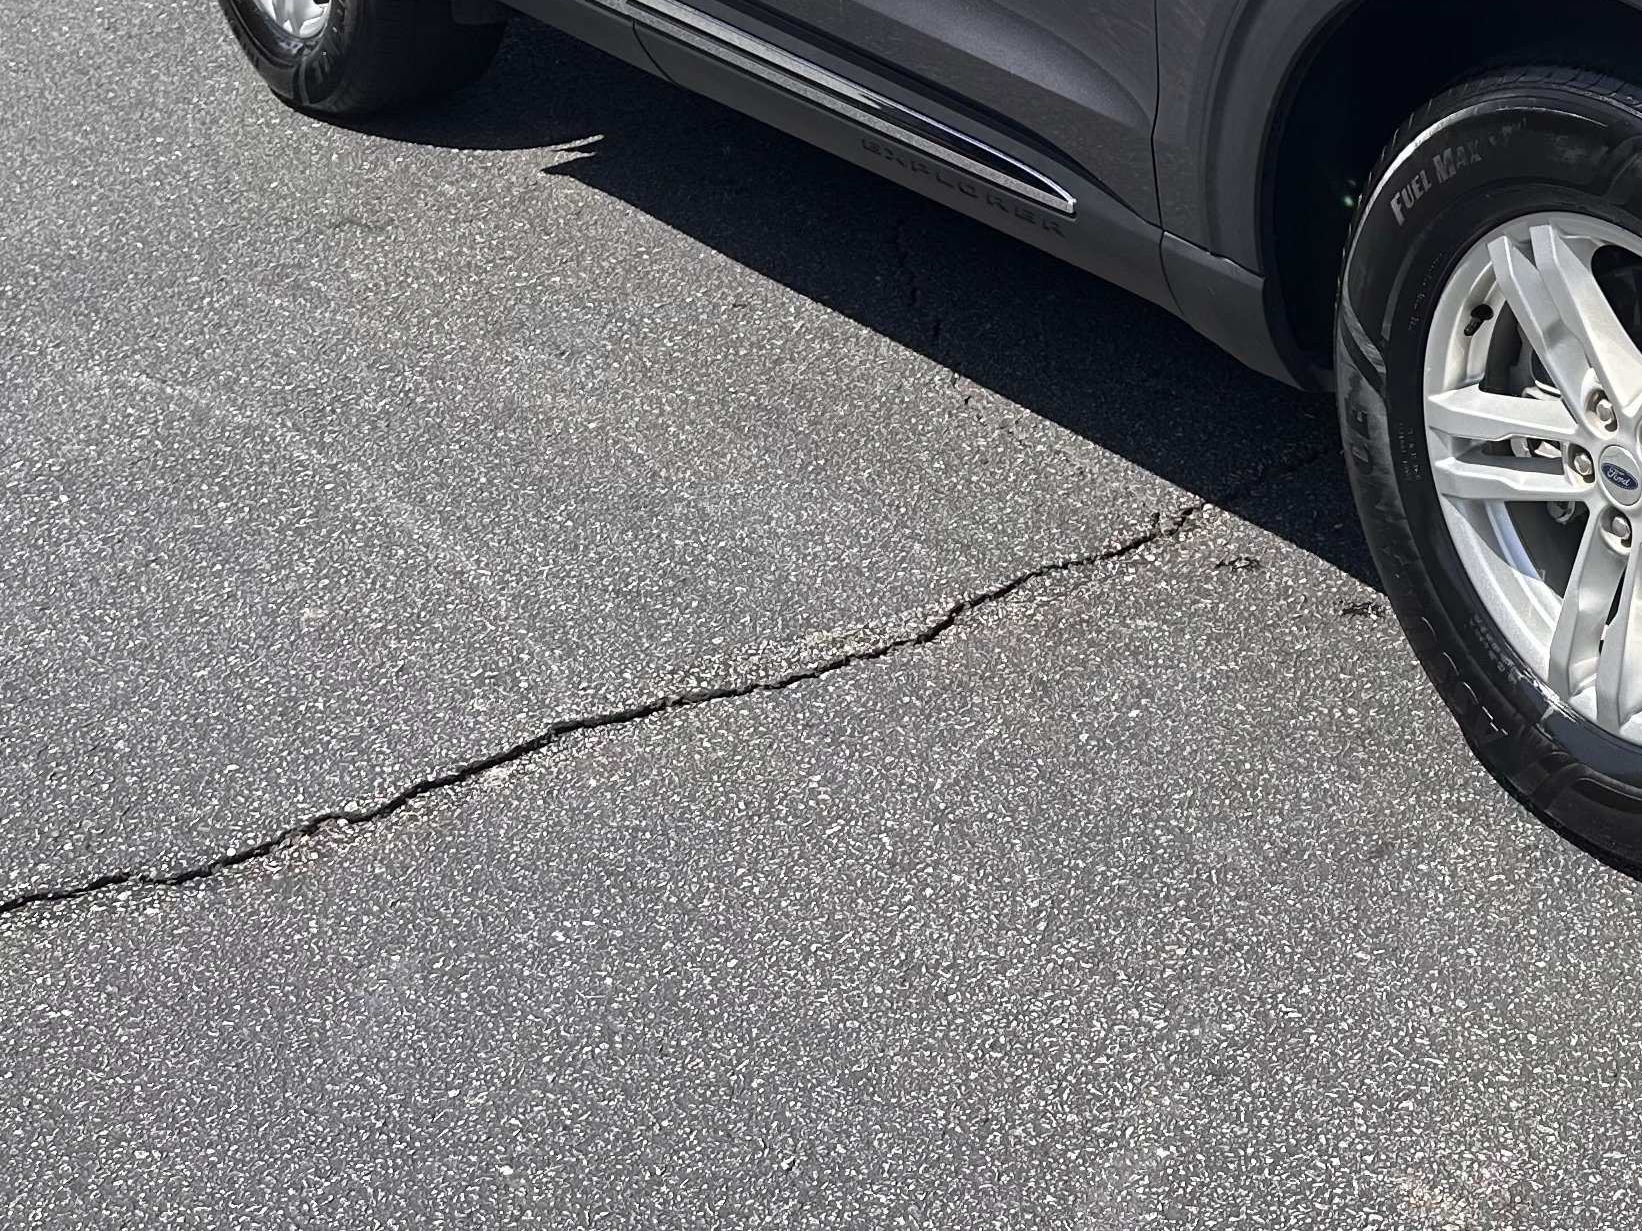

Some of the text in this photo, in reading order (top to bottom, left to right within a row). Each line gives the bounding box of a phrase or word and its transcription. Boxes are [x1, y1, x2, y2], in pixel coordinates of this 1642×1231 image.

[861, 138, 1066, 237] EXPLORER
[1390, 139, 1482, 226] FUEL MAX
[1605, 464, 1633, 487] Ford
